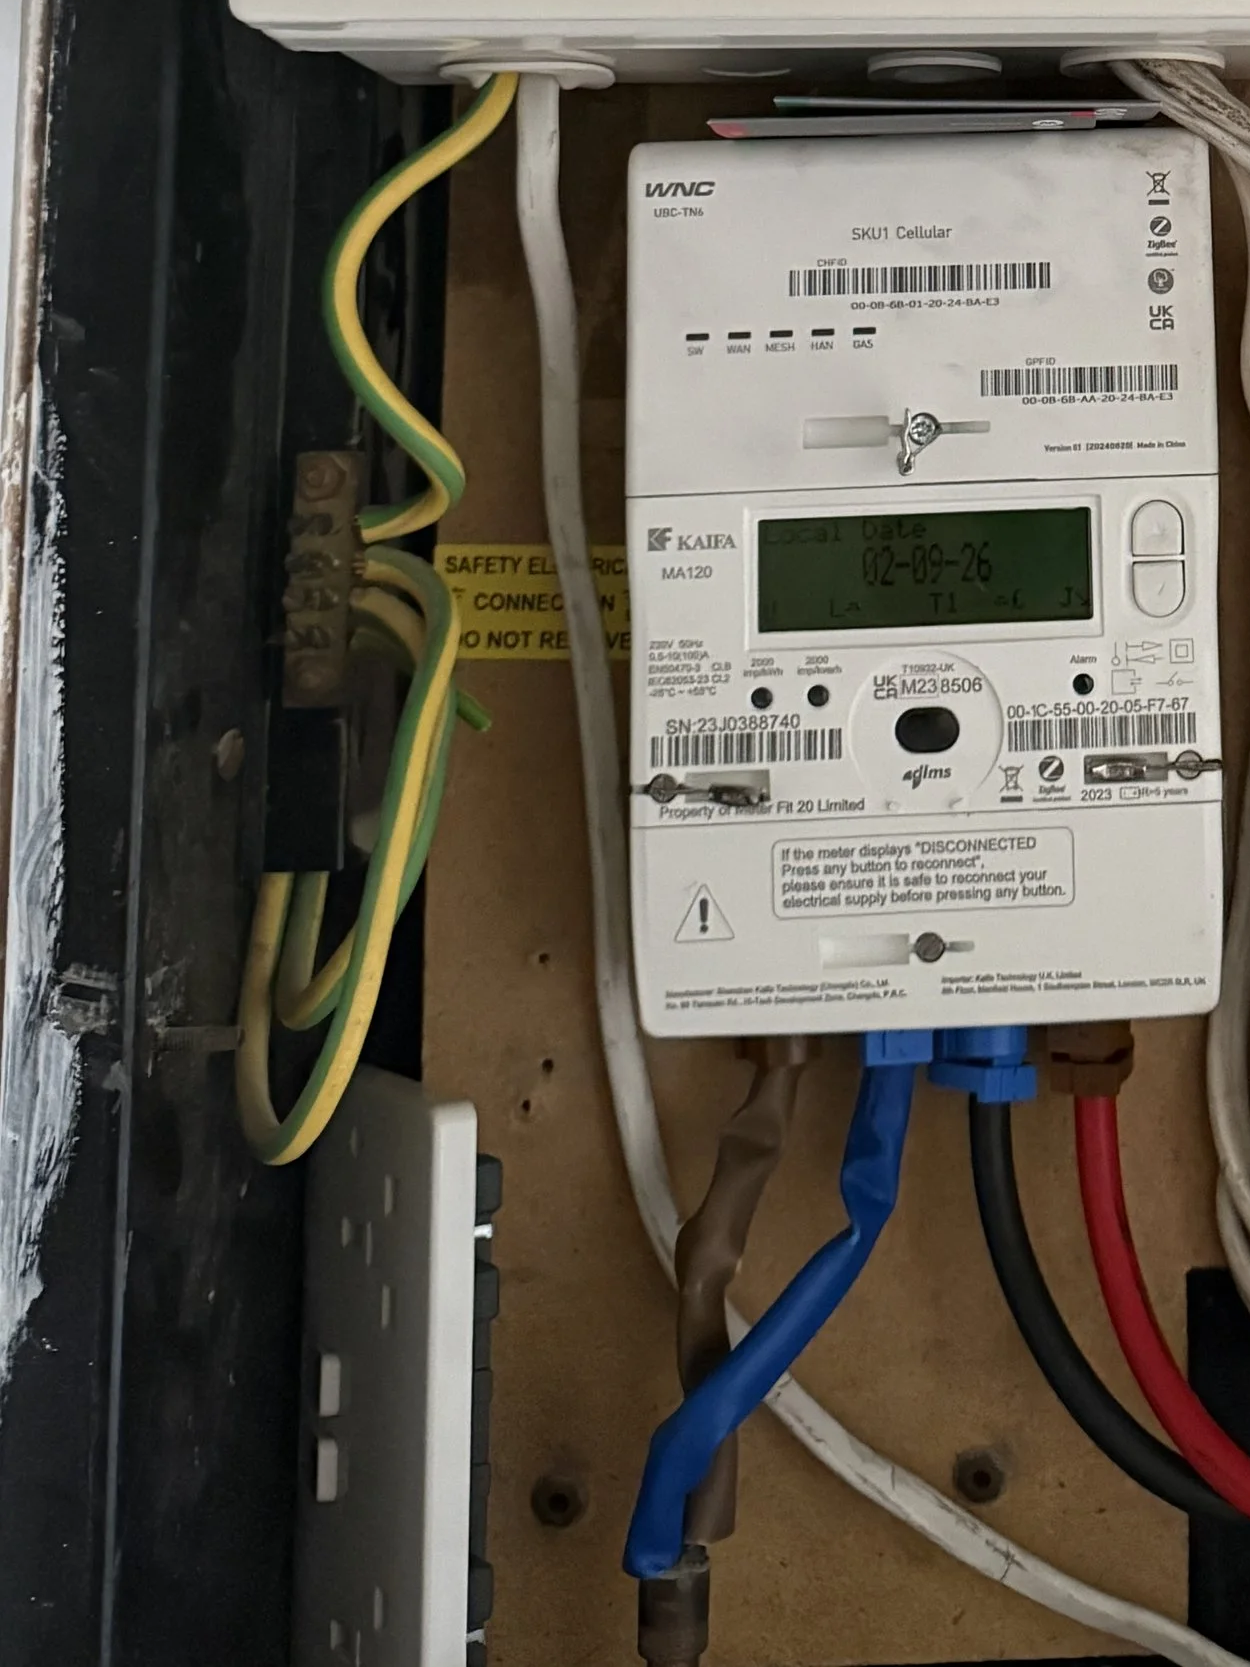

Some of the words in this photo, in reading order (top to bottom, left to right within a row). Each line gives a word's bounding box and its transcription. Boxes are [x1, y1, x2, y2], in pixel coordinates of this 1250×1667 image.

[646, 182, 716, 197] WNC
[852, 227, 888, 241] SKU1
[896, 226, 952, 239] Cellular
[1149, 306, 1173, 318] UK
[1150, 317, 1174, 330] CA
[688, 347, 704, 356] SW
[727, 345, 751, 354] WAN
[765, 342, 795, 352] MESH
[810, 341, 834, 350] HAN
[853, 339, 874, 349] GAS
[677, 534, 737, 551] KAIFA
[445, 556, 522, 574] SAFETY
[862, 542, 993, 585] 02-09-26
[662, 566, 713, 580] MA120
[474, 592, 615, 611] CONNECN
[458, 630, 481, 649] O
[487, 630, 532, 649] NOT
[1070, 655, 1097, 664] Alarm
[874, 675, 898, 687] UK
[901, 678, 938, 695] M23
[941, 677, 983, 693] 8506
[874, 688, 898, 700] CA
[1007, 697, 1189, 719] 00-1C-55-00-20-05-F7-67
[666, 714, 801, 735] SN:23J0388740
[1081, 788, 1112, 802] 2023
[660, 804, 715, 821] Property
[777, 800, 793, 814] Fit
[797, 800, 814, 813] 20
[818, 798, 865, 812] Limited
[782, 848, 790, 860] If
[793, 848, 814, 859] the
[818, 848, 856, 859] meter
[859, 845, 912, 858] displays
[782, 864, 820, 876] Press
[823, 864, 847, 876] any
[850, 860, 892, 873] button
[895, 859, 908, 871] to
